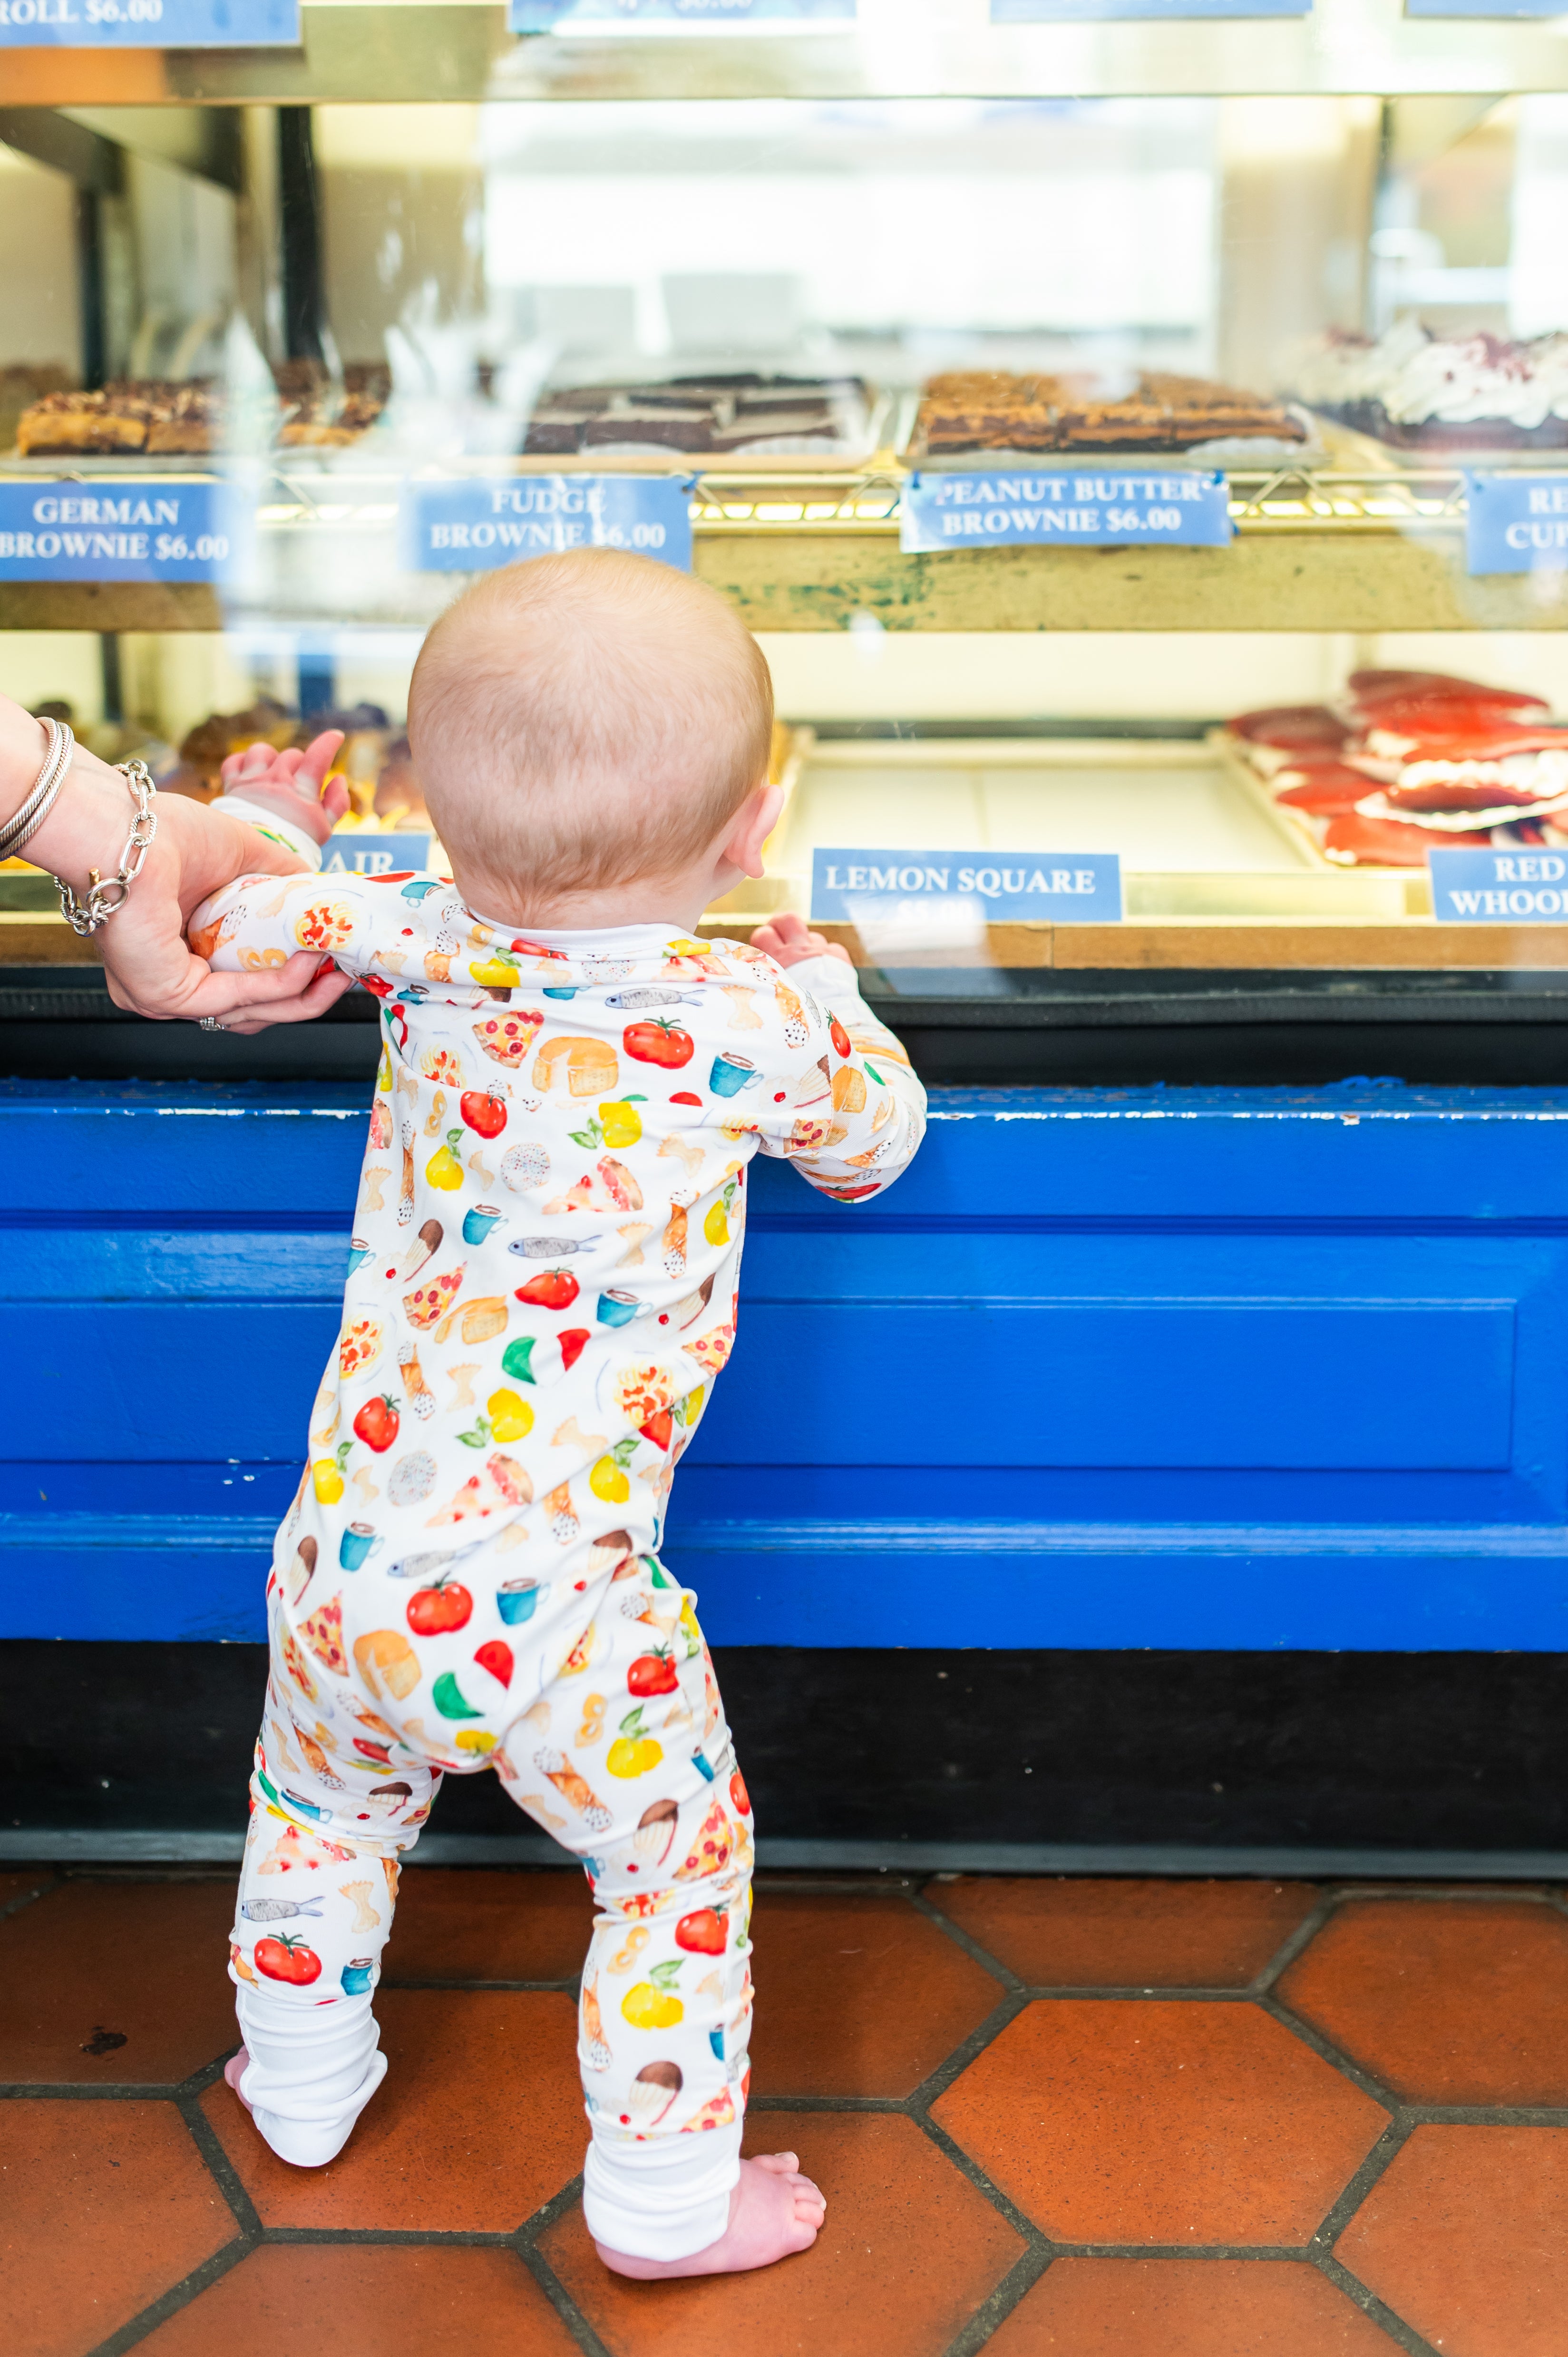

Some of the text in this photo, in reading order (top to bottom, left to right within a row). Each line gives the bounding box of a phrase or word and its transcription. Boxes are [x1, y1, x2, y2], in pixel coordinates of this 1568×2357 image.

[86, 0, 163, 24] $6.00
[492, 487, 607, 514] FUDGE
[935, 477, 1203, 506] PEANUT BUTTER
[33, 497, 180, 525] GERMAN
[943, 506, 1182, 536] BROWNIE $6.00
[0, 531, 229, 561] BROWNIE $6.00
[431, 522, 585, 548] BROWNIE
[826, 866, 1095, 897] LEMON SQUARE
[1494, 856, 1566, 882] RED
